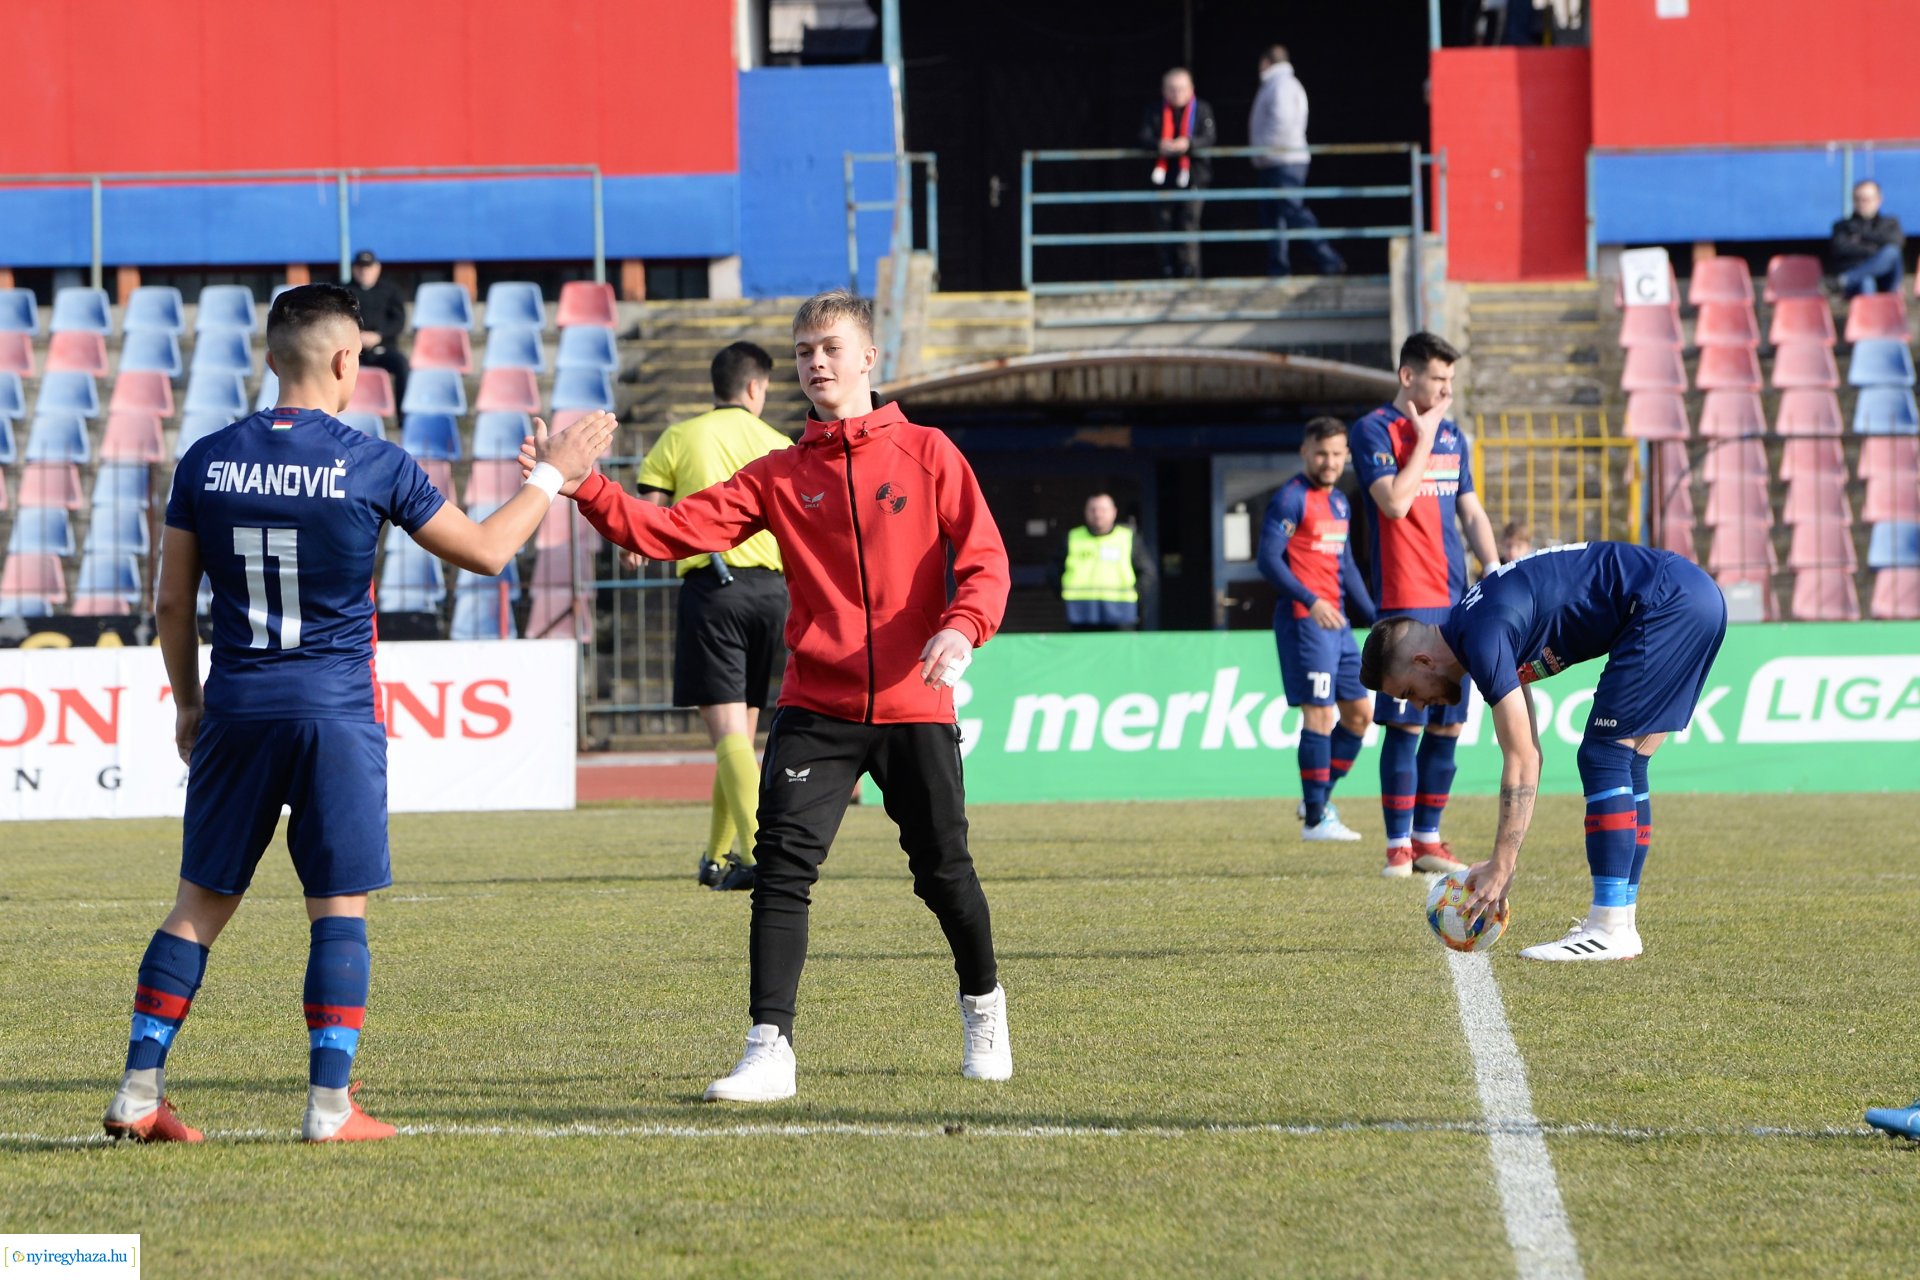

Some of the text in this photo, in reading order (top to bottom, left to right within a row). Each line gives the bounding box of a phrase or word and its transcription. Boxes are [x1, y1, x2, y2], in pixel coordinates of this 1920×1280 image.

[1636, 273, 1657, 301] C
[204, 459, 346, 499] SINANOVIČ
[233, 527, 302, 650] 11
[1766, 677, 1920, 721] LIGA
[1594, 717, 1618, 728] JAKO
